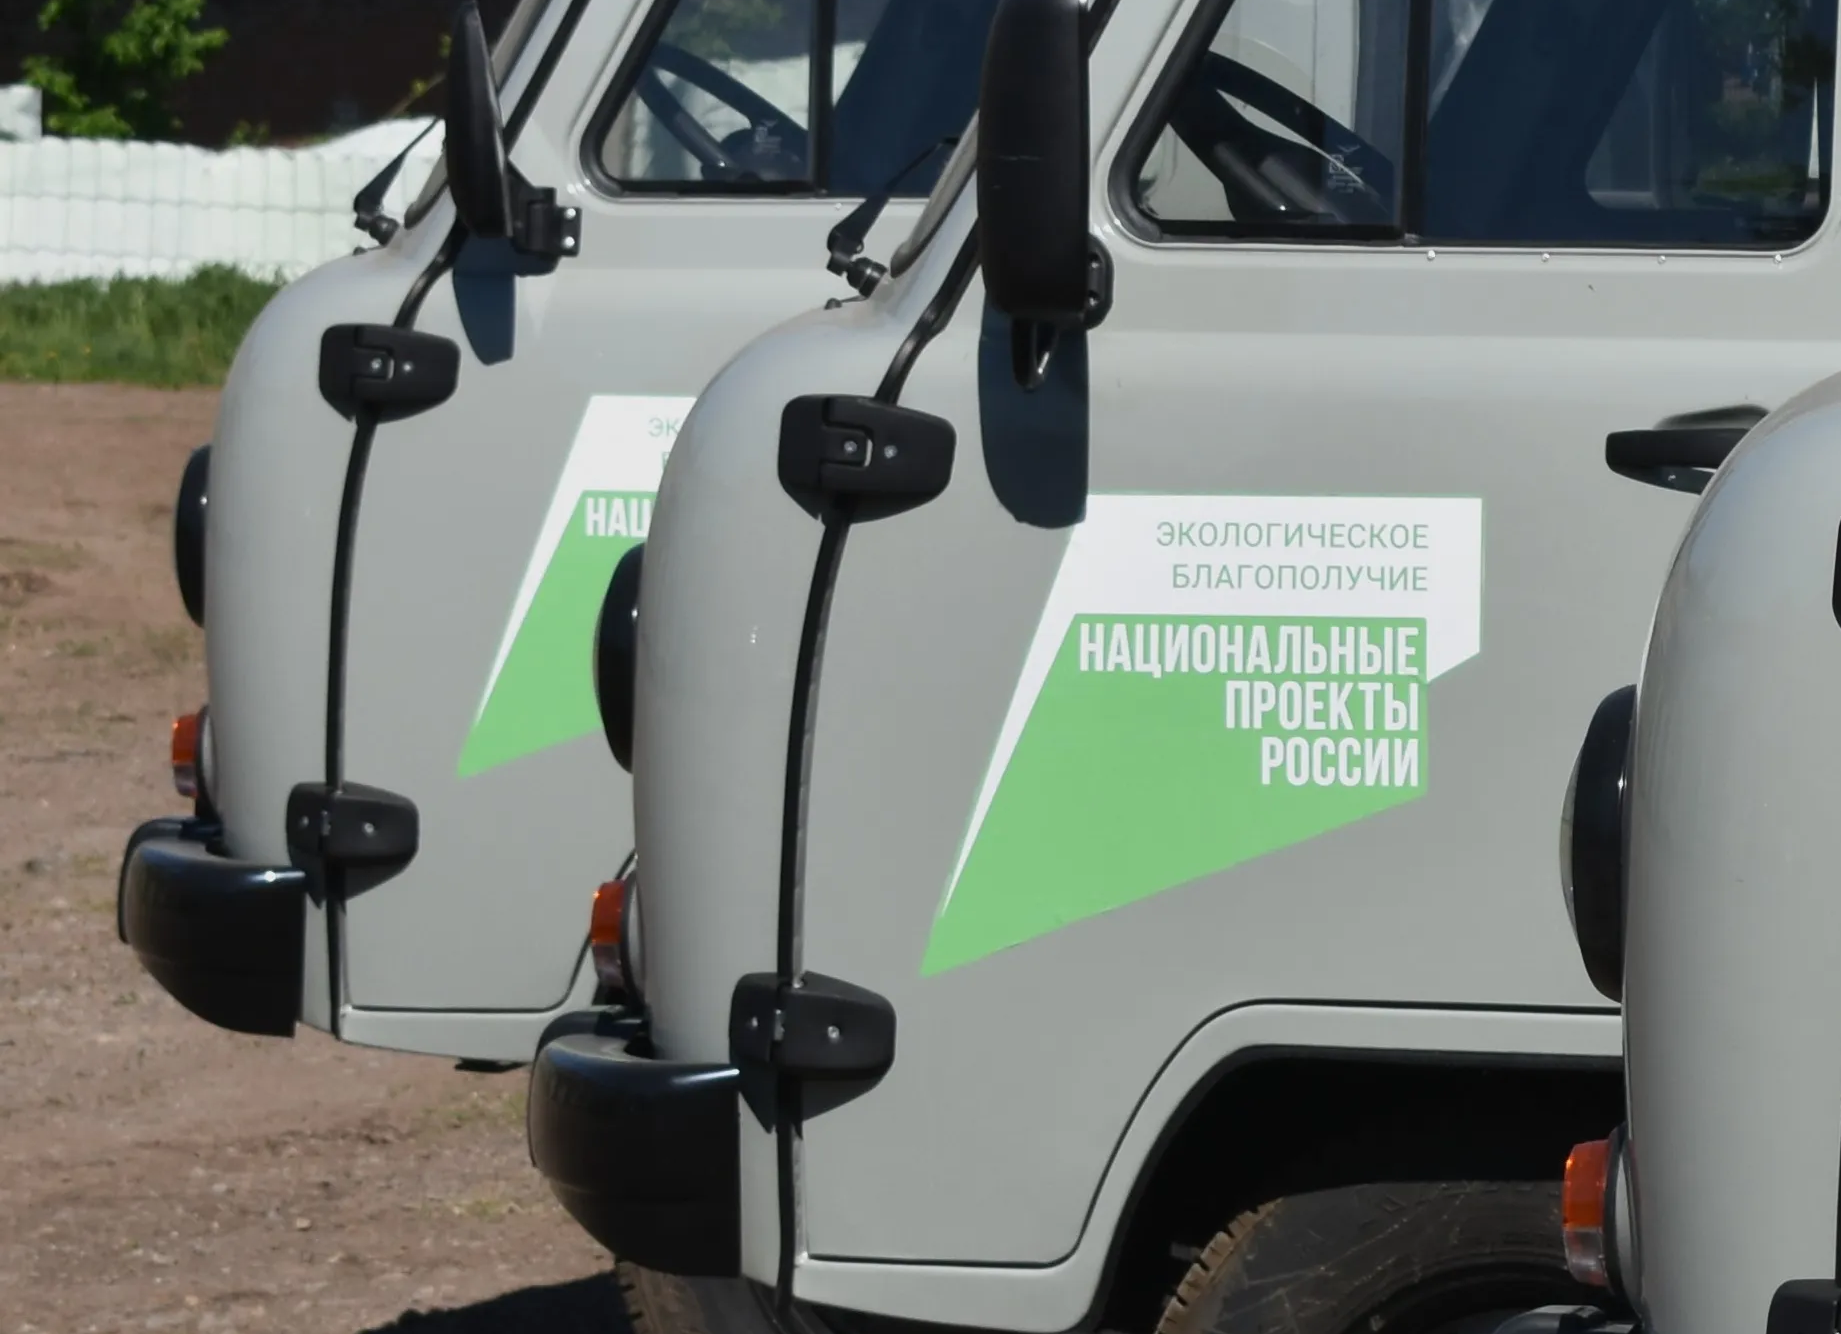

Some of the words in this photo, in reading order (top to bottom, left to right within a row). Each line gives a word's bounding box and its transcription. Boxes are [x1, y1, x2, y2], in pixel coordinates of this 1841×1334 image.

[1155, 521, 1430, 550] ЭКОЛОГИЧЕСКОЕ
[1171, 563, 1429, 592] БЛАГОПОЛУЧИЕ
[1079, 622, 1420, 679] НАЦИОНАЛЬНЫЕ
[1225, 680, 1420, 731] ПРОЕКТЫ
[1261, 736, 1420, 787] РОССИИ
